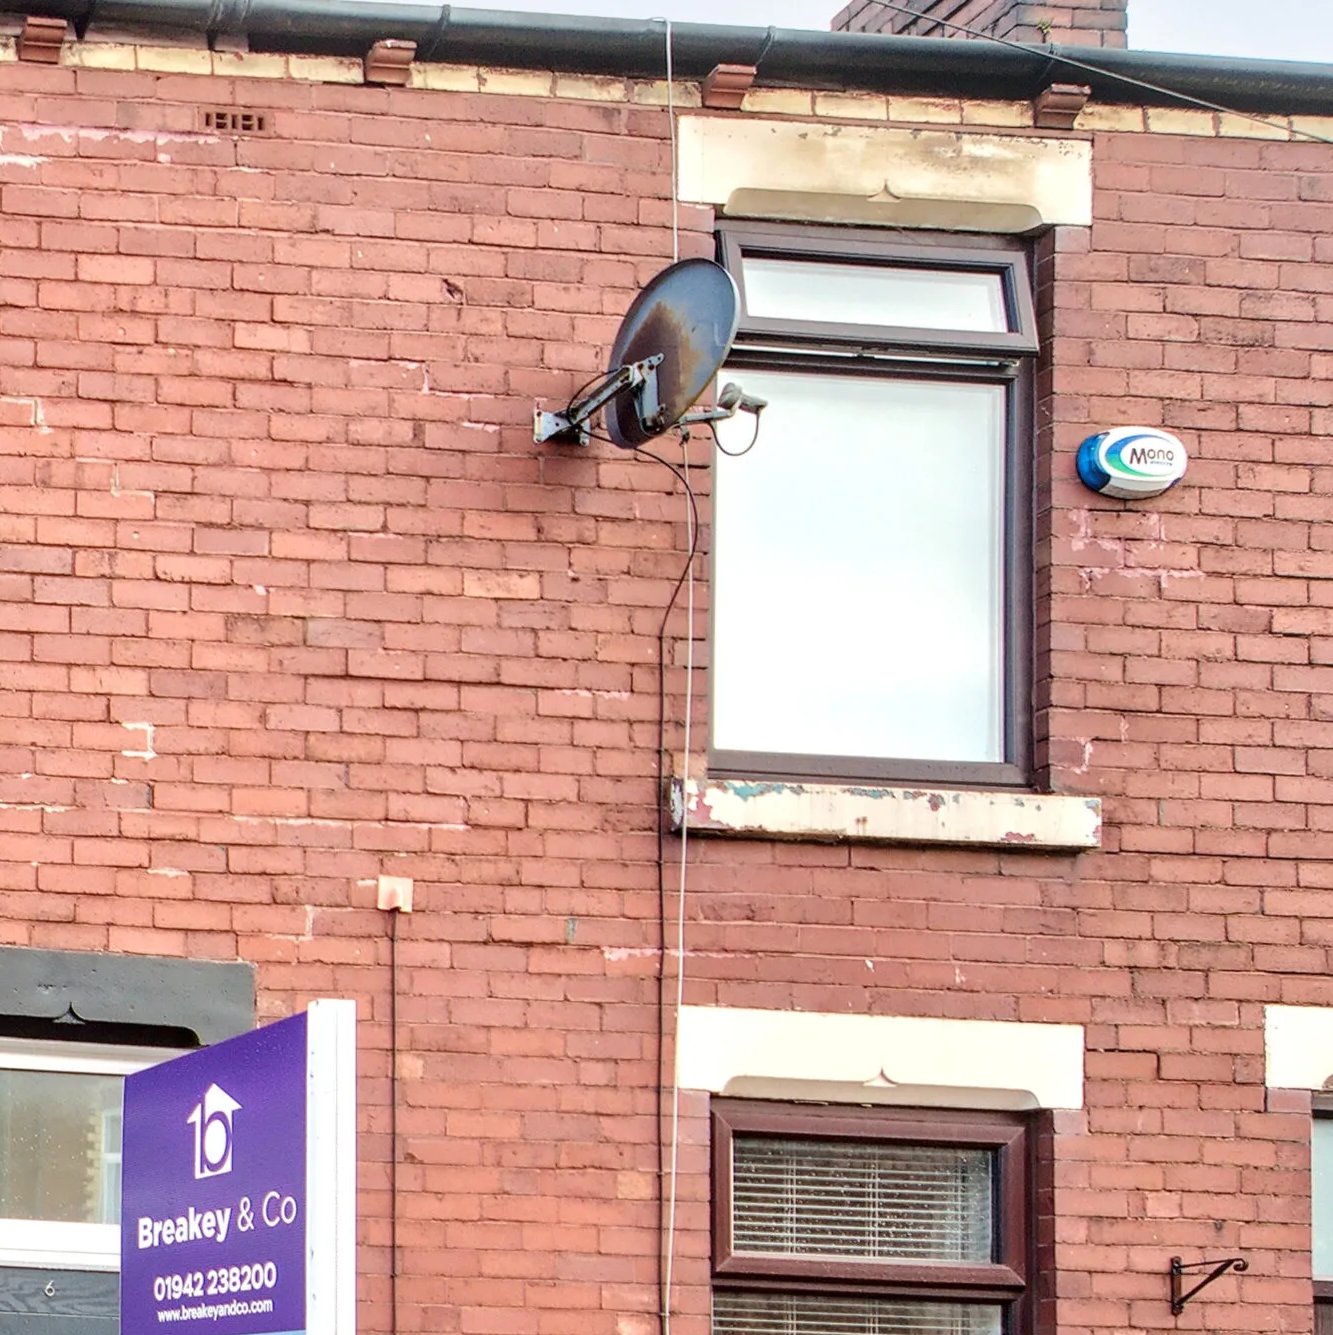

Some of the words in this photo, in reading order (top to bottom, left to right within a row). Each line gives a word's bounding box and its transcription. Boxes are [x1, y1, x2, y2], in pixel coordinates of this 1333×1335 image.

[1129, 447, 1175, 465] Mono
[137, 1206, 232, 1249] Breakey
[237, 1196, 255, 1232] &
[262, 1191, 297, 1227] Co
[44, 1280, 56, 1297] 6
[153, 1271, 205, 1301] 01942
[207, 1261, 277, 1295] 238200
[157, 1299, 274, 1322] www.breakeyandco.com
